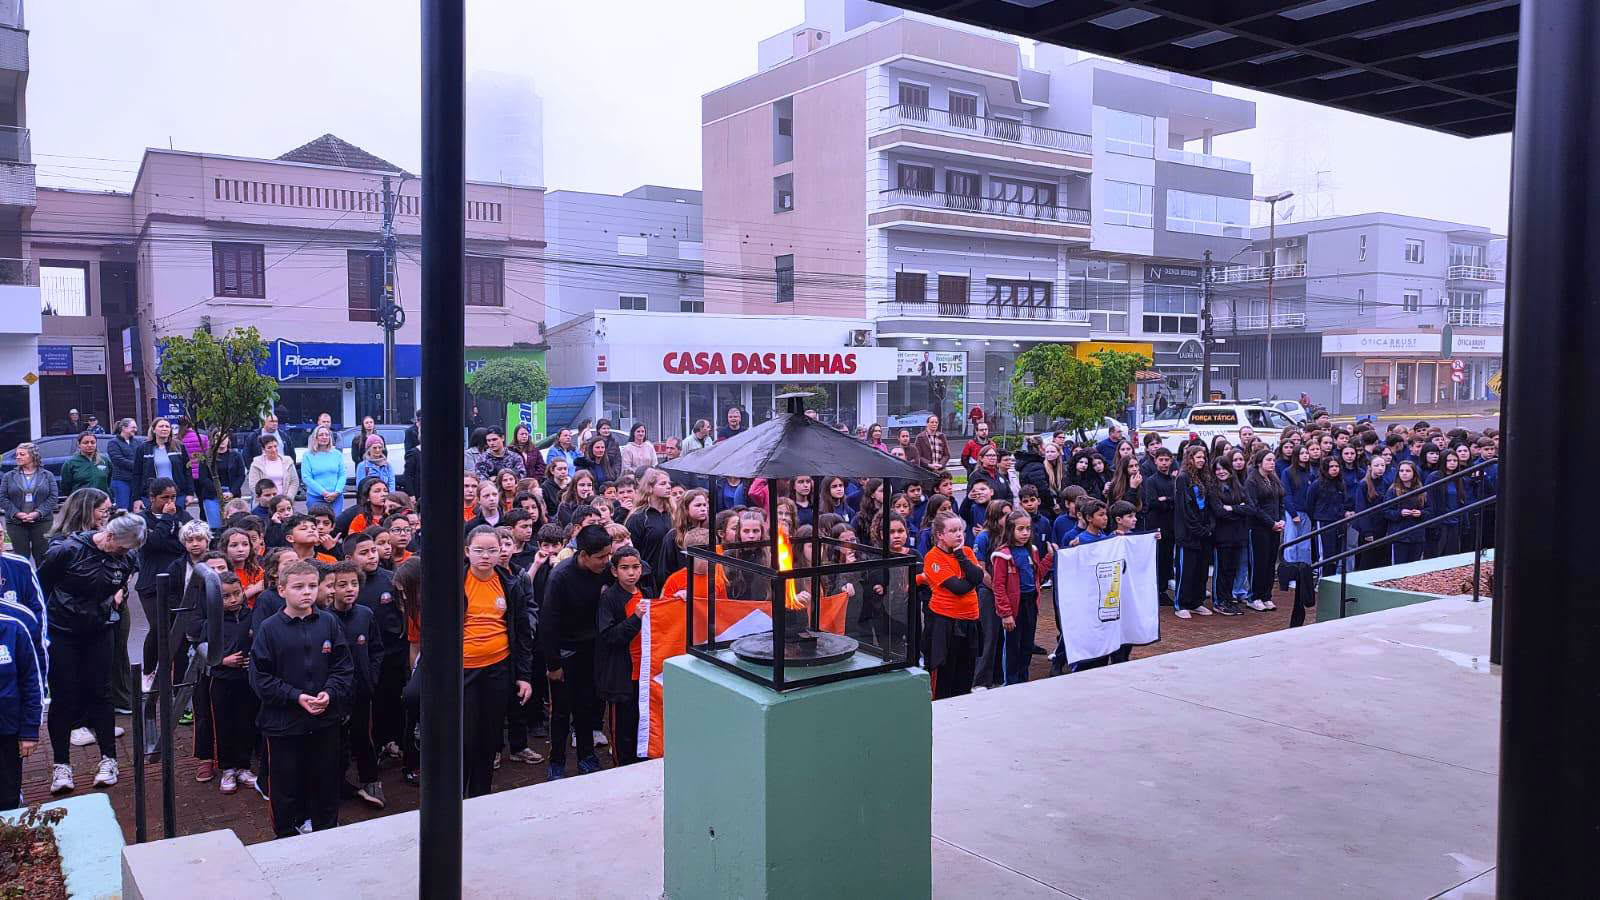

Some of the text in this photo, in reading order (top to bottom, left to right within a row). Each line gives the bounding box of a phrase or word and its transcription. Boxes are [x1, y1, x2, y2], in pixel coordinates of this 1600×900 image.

[285, 355, 341, 366] Ricardo
[663, 352, 857, 375] CASA DAS LINHAS
